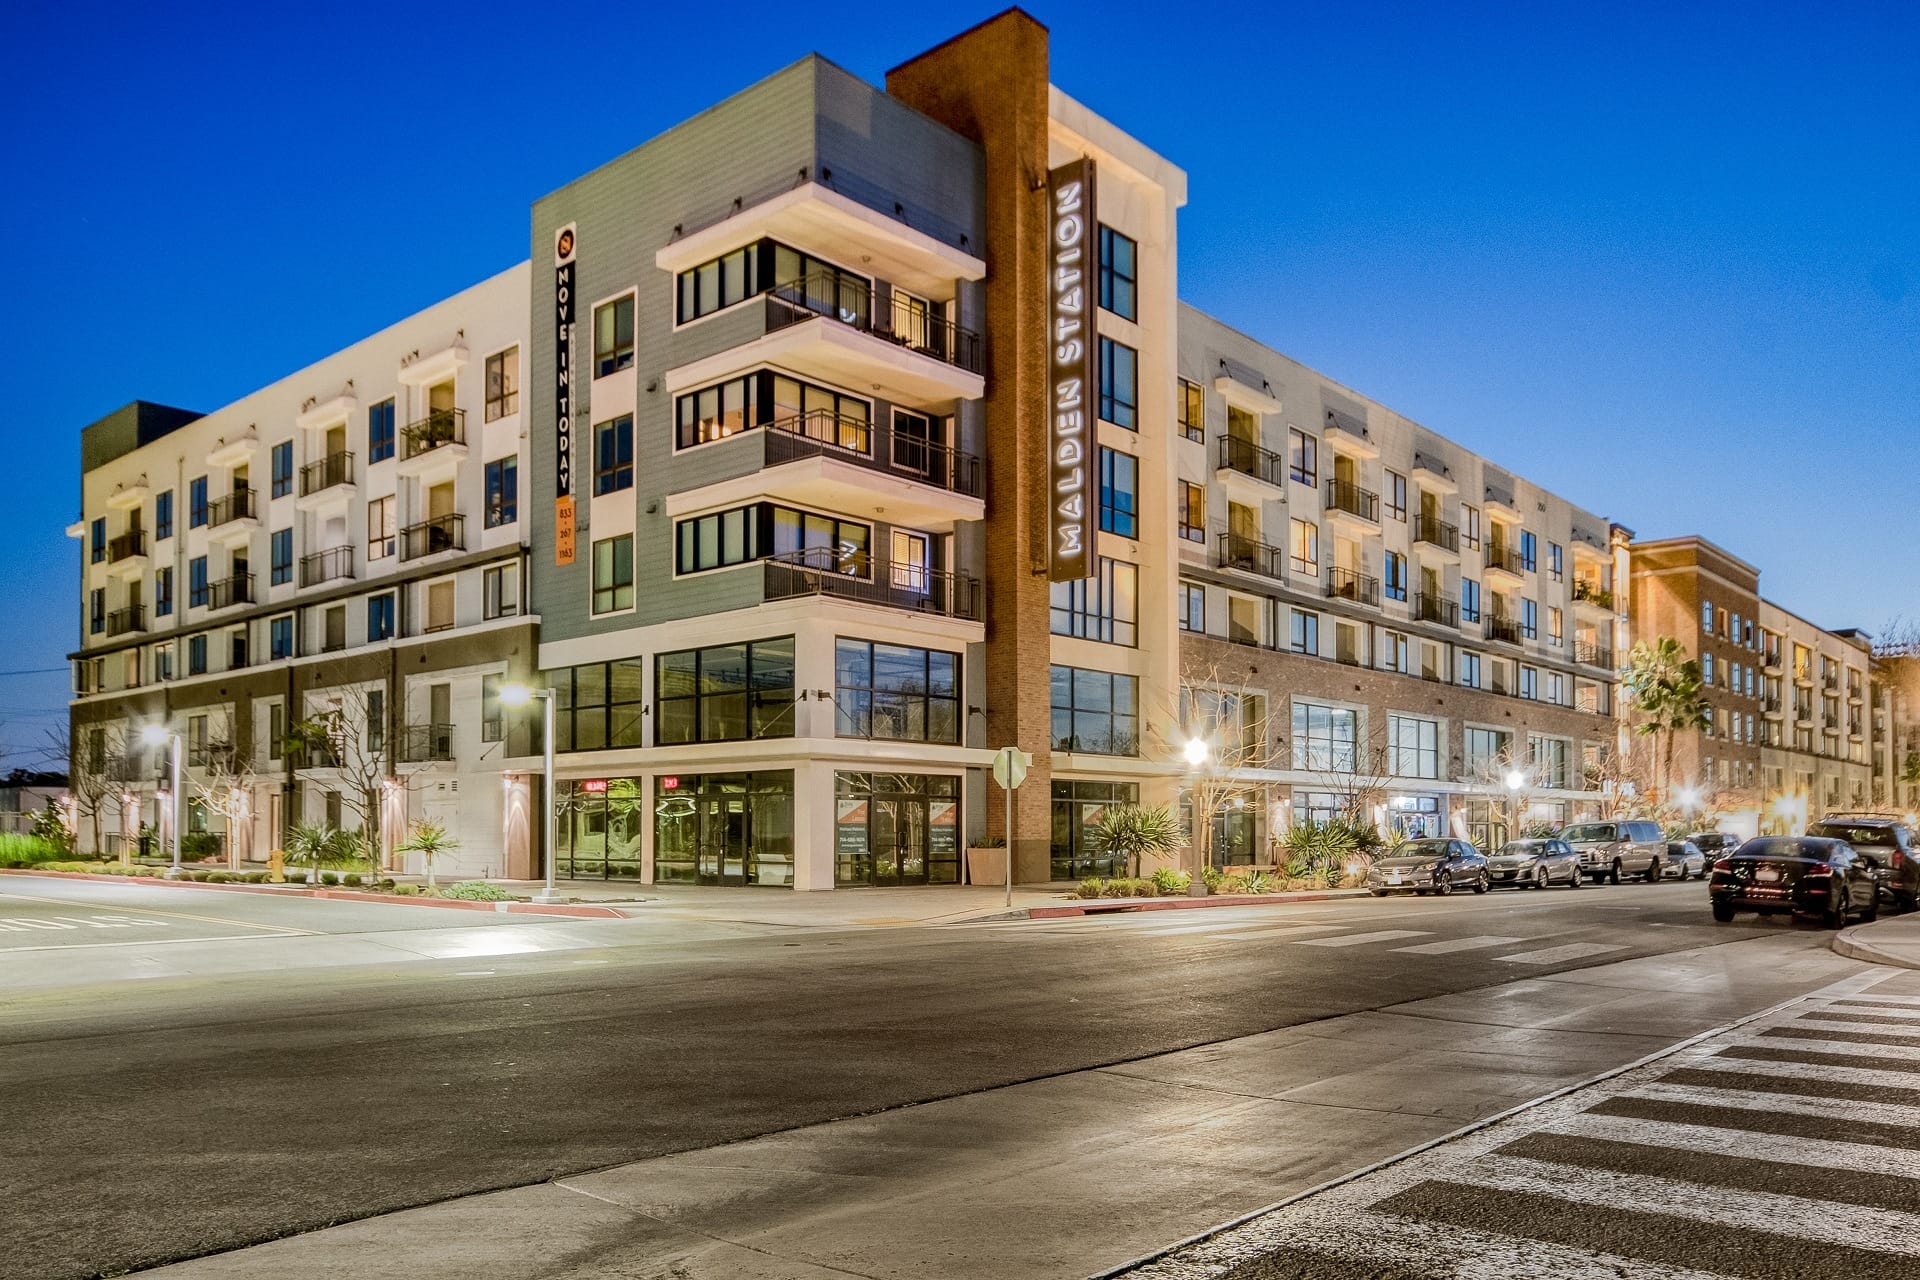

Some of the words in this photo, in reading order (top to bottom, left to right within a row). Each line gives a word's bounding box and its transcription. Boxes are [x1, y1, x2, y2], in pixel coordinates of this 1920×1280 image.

[1057, 181, 1083, 365] STATION
[559, 352, 568, 387] IN
[559, 397, 568, 489] TODAY
[1057, 378, 1083, 555] MALDEN
